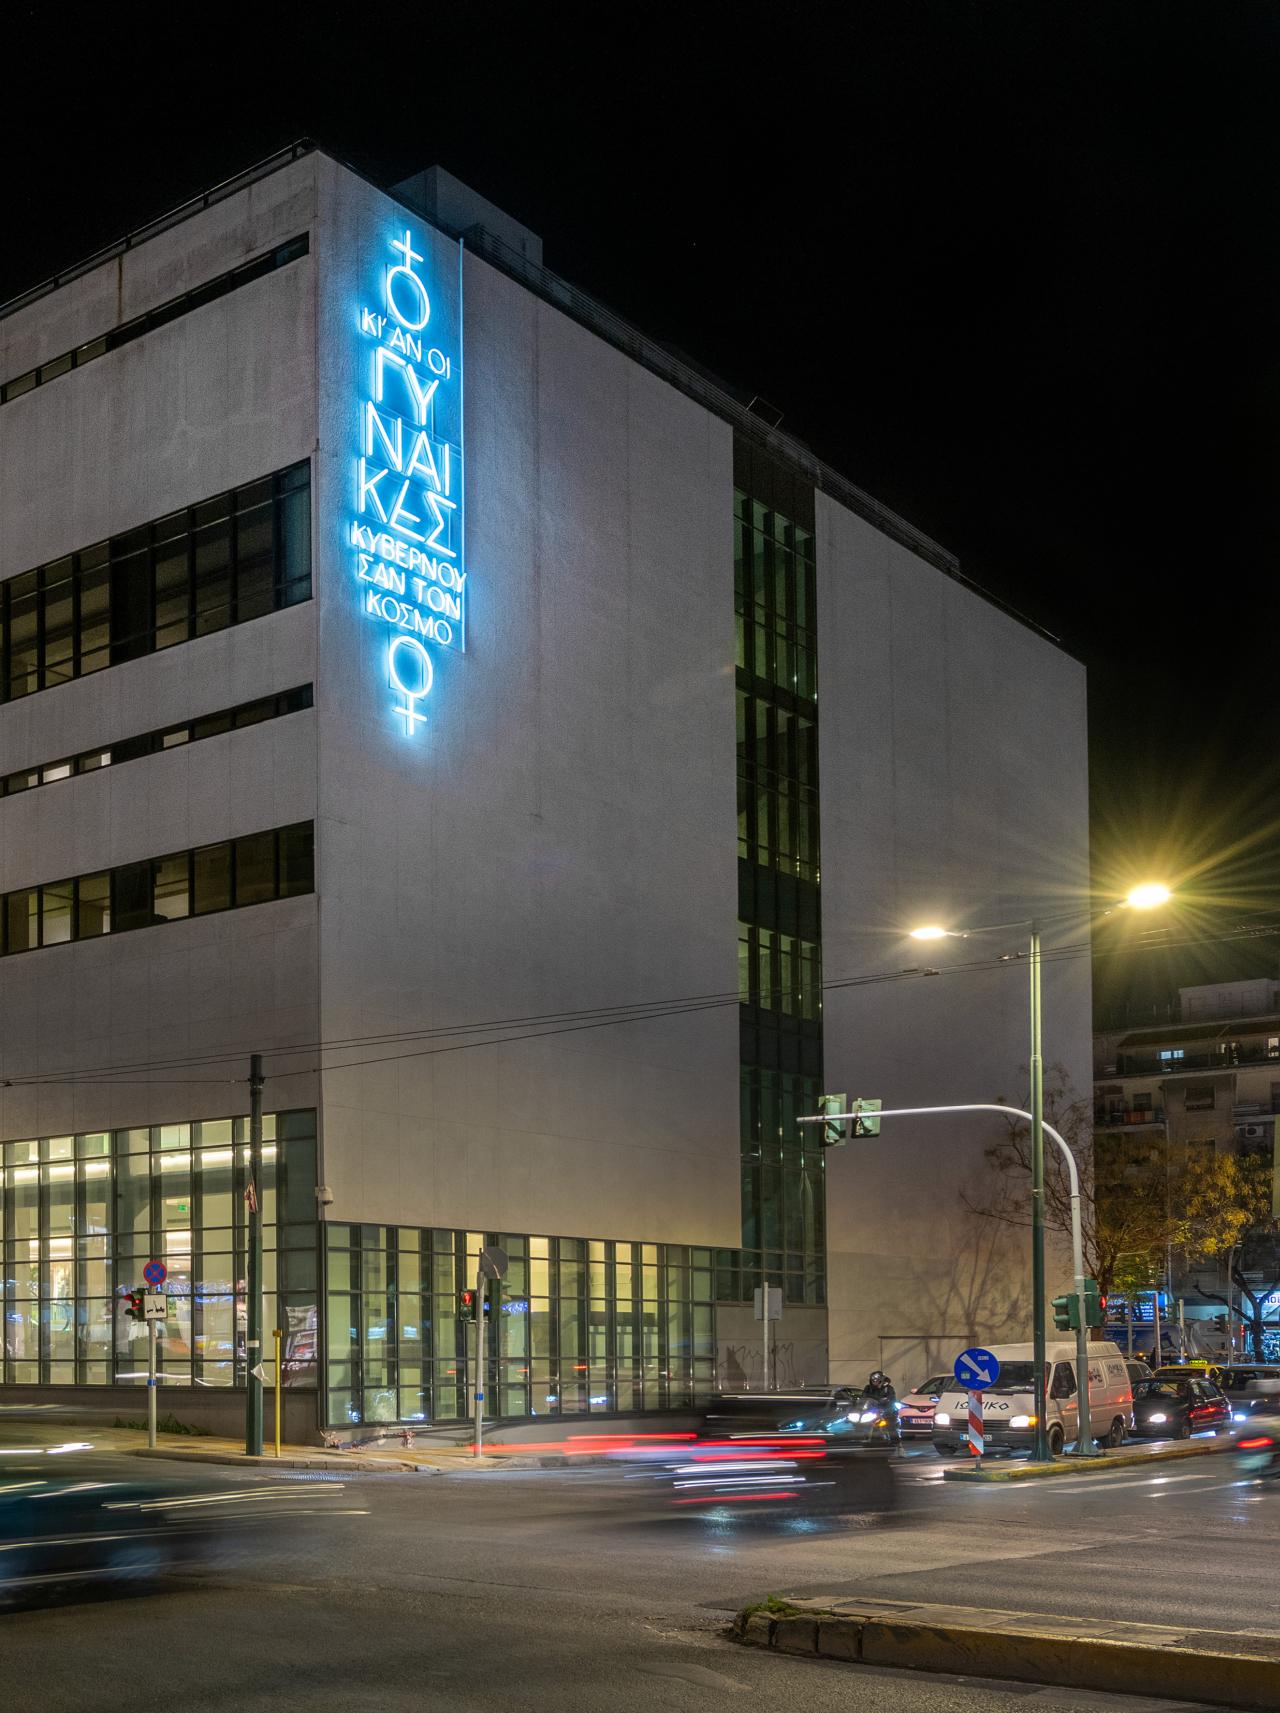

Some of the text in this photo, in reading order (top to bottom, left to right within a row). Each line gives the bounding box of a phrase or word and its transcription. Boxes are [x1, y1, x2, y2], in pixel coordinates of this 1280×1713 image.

[377, 346, 439, 425] ΓΥ
[390, 326, 421, 362] ΑΝ
[428, 348, 450, 379] ΟΙ
[368, 400, 449, 496] ΝΑΙ
[360, 456, 457, 557] ΚΕΣ
[352, 520, 467, 593] ΚΥΒΕΡΝΟΥ
[358, 553, 461, 620] ΣΑΝ ΤΟΝ
[367, 589, 452, 644] ΚΟΣΜΟ
[954, 1401, 1009, 1411] ΙΩΙΚΟ
